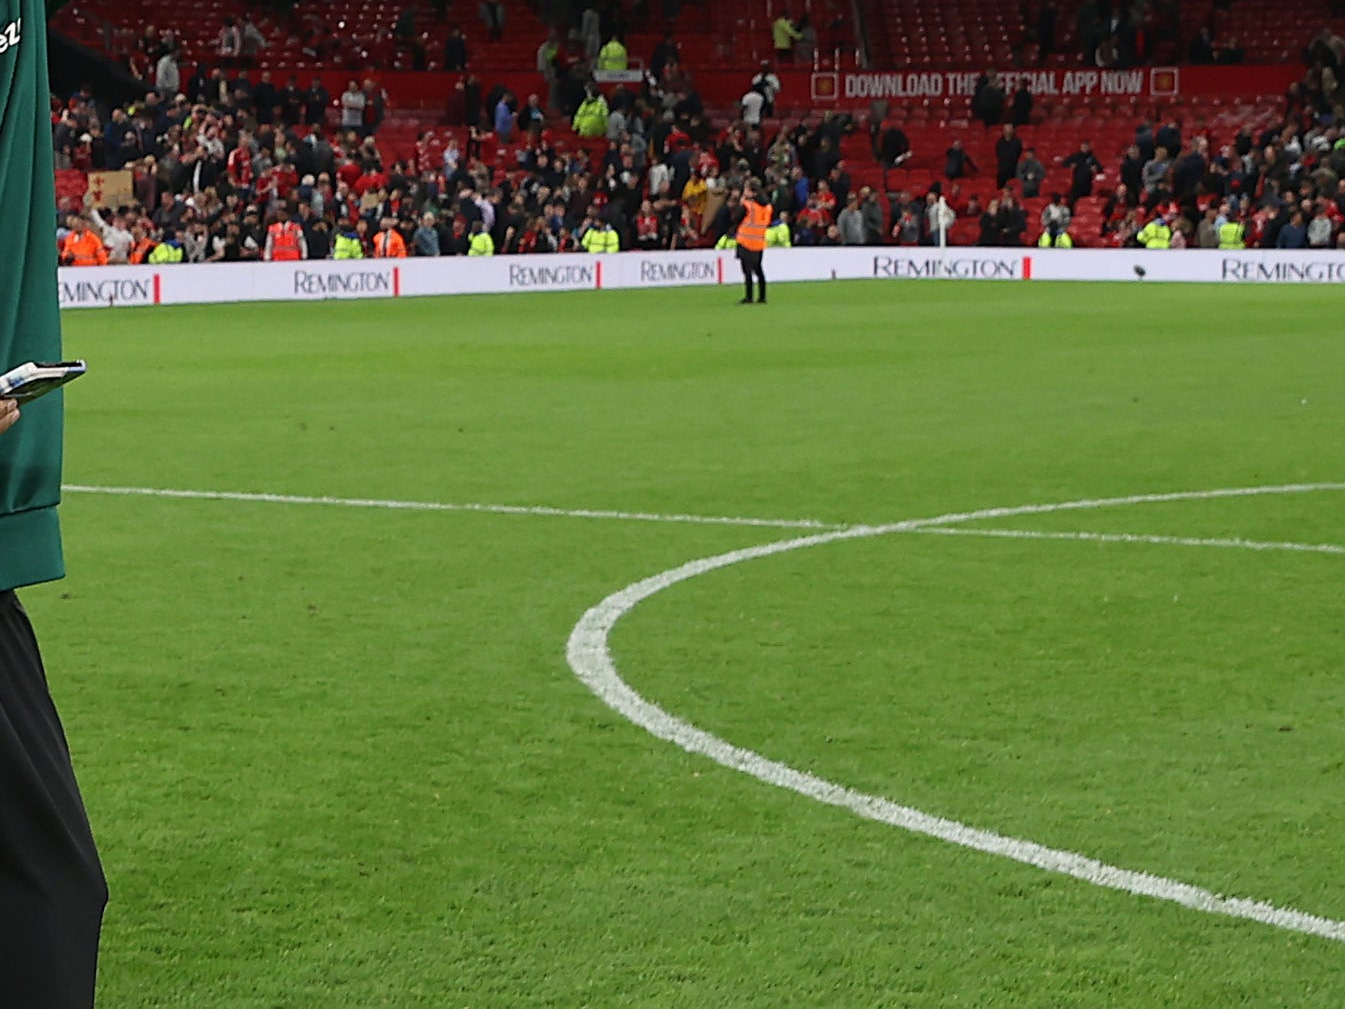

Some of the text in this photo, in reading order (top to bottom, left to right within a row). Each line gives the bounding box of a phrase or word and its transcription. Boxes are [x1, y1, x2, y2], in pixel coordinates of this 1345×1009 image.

[845, 72, 944, 98] DOWNLOAD
[945, 71, 982, 97] THE
[1062, 70, 1099, 96] APP
[1100, 68, 1144, 96] NOW
[509, 264, 592, 287] REMINGTON
[641, 260, 715, 282] REMINGTON
[873, 256, 1016, 278] REMINGTON
[294, 270, 389, 294] REMINGTON
